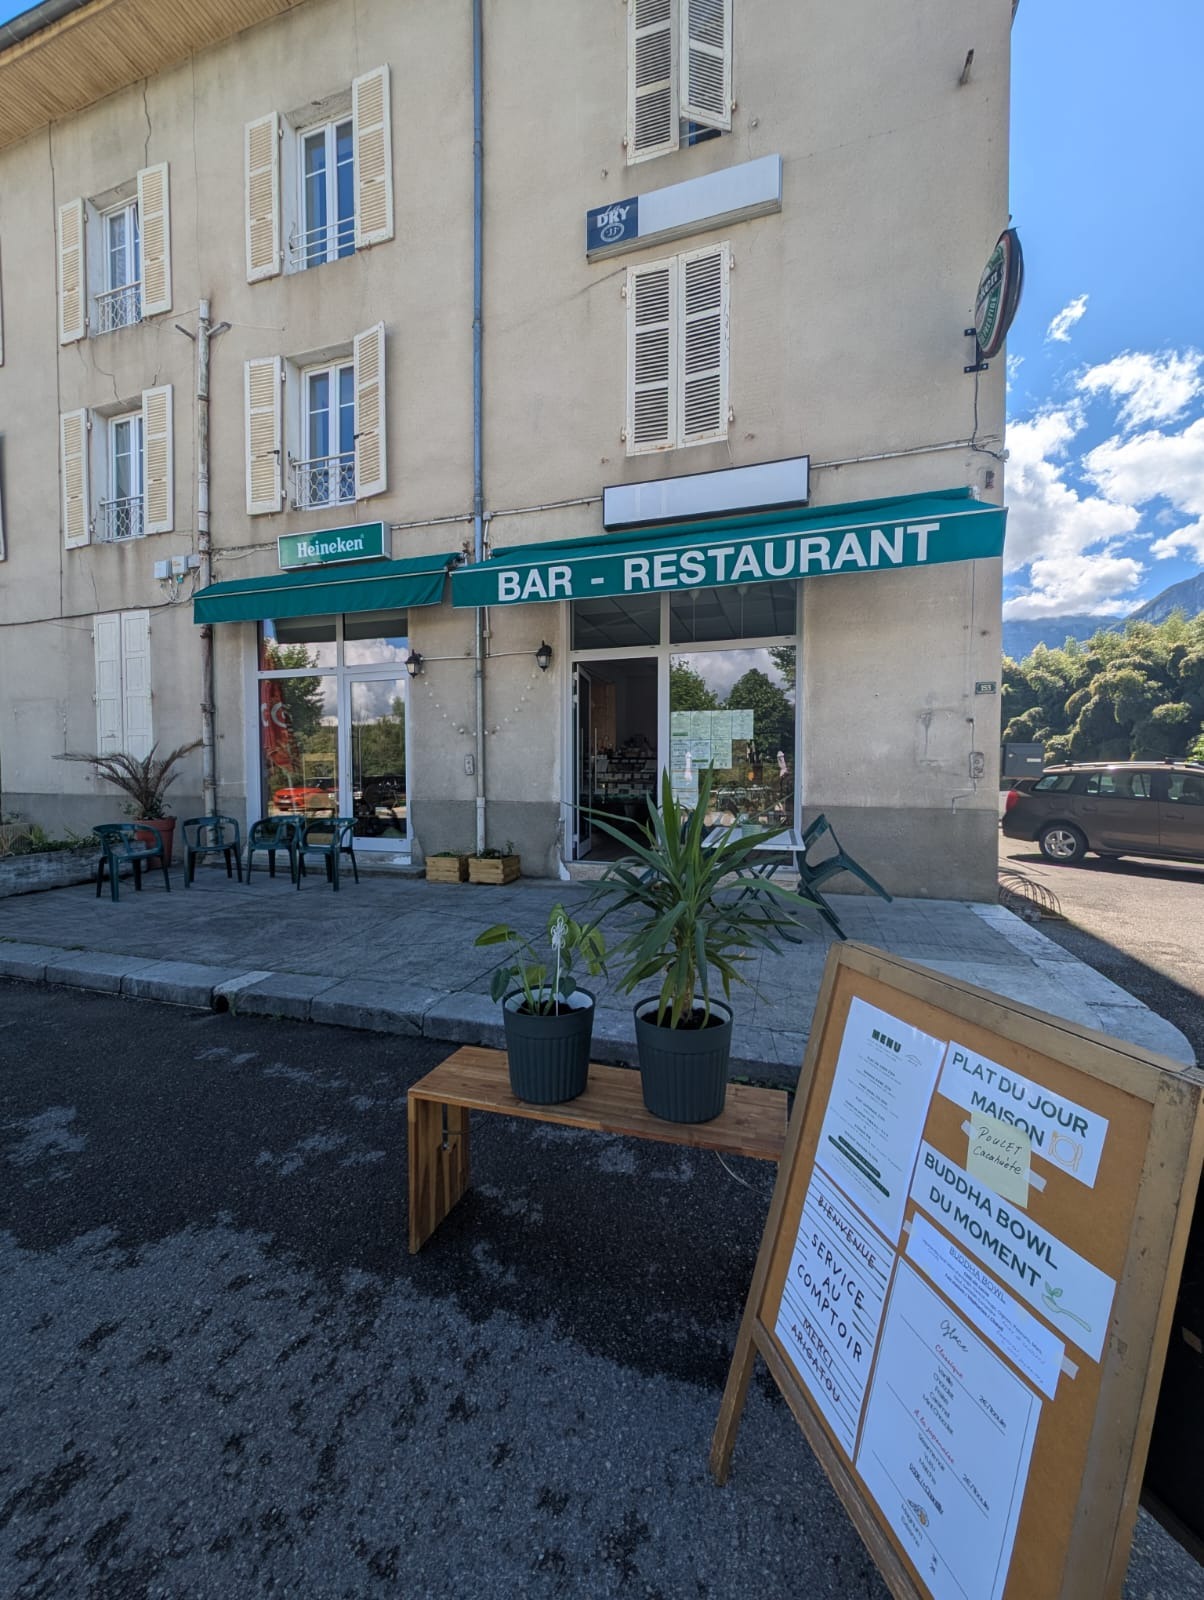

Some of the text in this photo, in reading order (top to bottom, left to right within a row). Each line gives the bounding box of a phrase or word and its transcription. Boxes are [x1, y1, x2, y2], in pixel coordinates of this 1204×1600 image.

[597, 206, 630, 228] DRY
[297, 537, 363, 558] Heineken
[498, 565, 573, 601] BAR
[624, 523, 940, 590] RESTAURANT
[872, 1029, 902, 1052] MENU
[952, 1052, 1089, 1138] PLAT DU JOUR
[979, 1126, 1022, 1155] POULET
[818, 1195, 876, 1269] BIENVENUE
[924, 1152, 992, 1217] BUDDHA
[996, 1207, 1058, 1270] BOWL
[929, 1185, 952, 1213] DU
[953, 1206, 1042, 1287] MOMENT
[811, 1233, 865, 1310] SERVICE
[822, 1276, 841, 1302] AU
[949, 1246, 980, 1281] BUDDHA
[981, 1276, 1006, 1305] BOWL
[797, 1264, 862, 1363] COMPTOIR
[803, 1318, 833, 1369] MERCI
[791, 1323, 840, 1402] ARIGATOU
